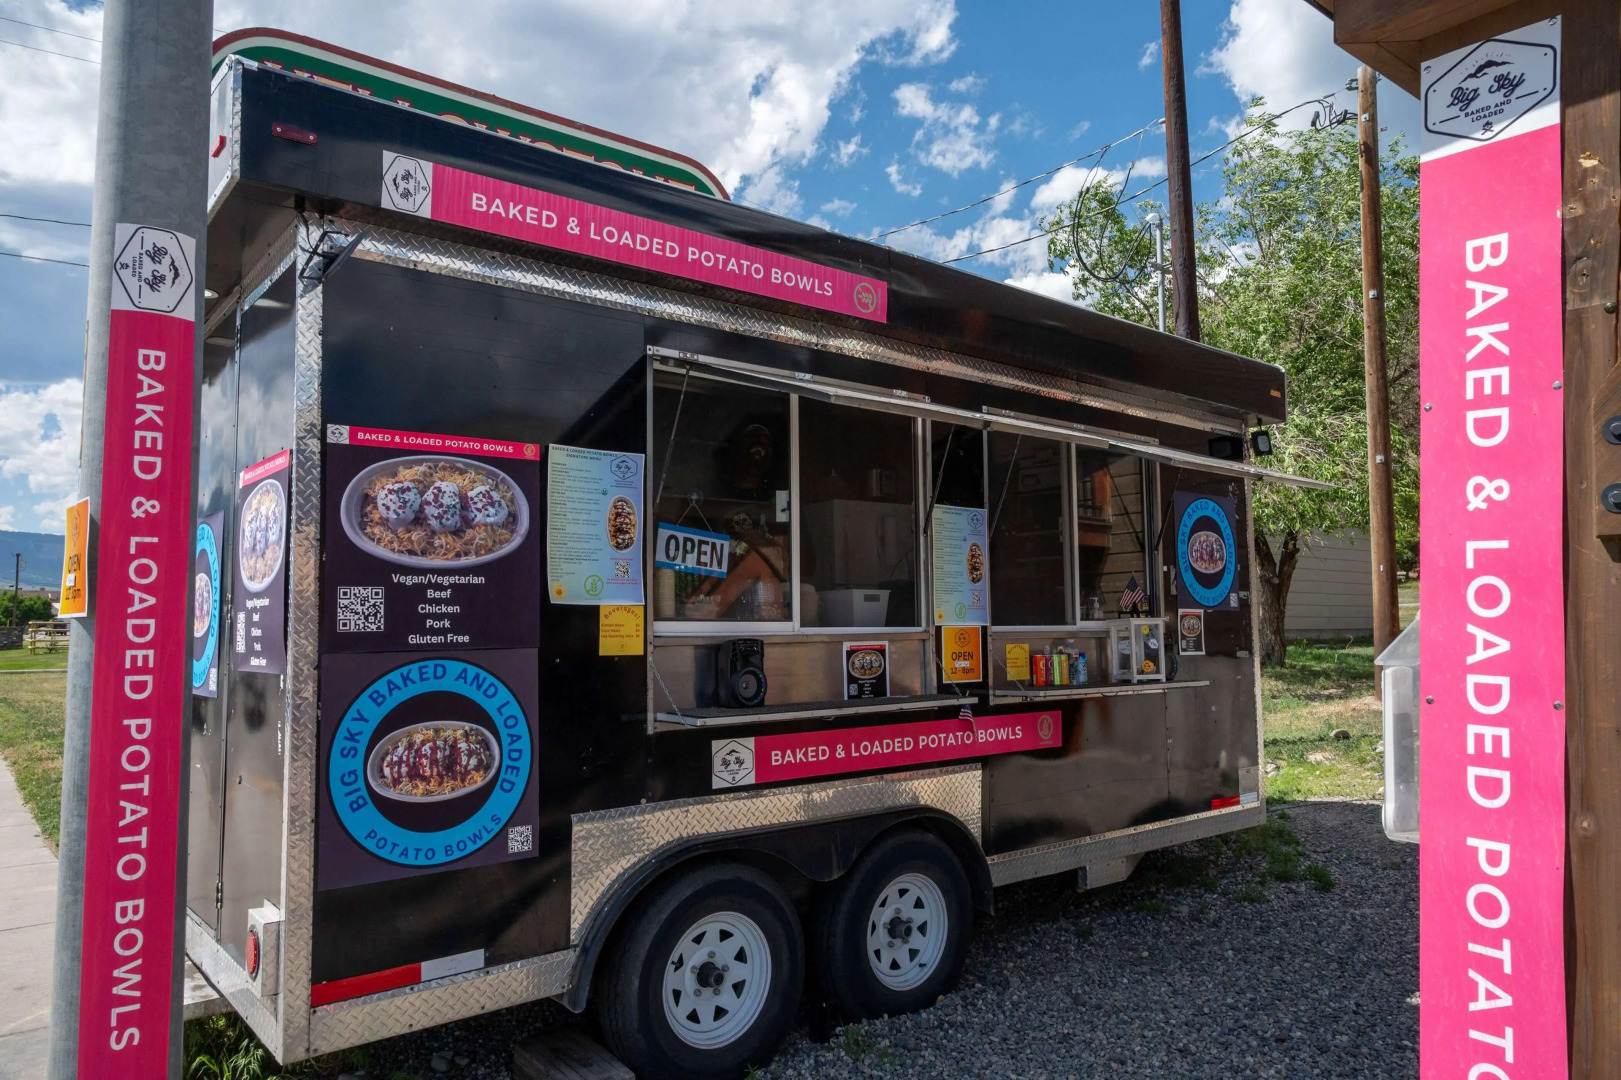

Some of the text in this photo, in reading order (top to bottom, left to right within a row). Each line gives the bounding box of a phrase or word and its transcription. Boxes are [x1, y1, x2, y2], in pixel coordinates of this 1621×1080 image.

[1446, 72, 1526, 112] Big Sky
[1464, 98, 1512, 118] BAKED AND
[1471, 108, 1504, 123] LOADED
[471, 192, 833, 296] BAKED & LOADED POTATO BOWLS
[144, 242, 168, 293] Big Sky
[1465, 232, 1510, 448] BAKED
[358, 432, 391, 442] BAKED
[404, 436, 442, 446] LOADED
[445, 440, 480, 450] POTATO
[483, 443, 513, 453] BOWLS
[1466, 475, 1510, 512] &
[665, 534, 724, 569] OPEN
[1180, 522, 1189, 544] SKY
[1187, 501, 1208, 518] BAKED
[1211, 504, 1224, 523] AND
[1223, 526, 1233, 575] LOADED
[392, 574, 485, 585] Vegan/Vegetarian
[427, 589, 452, 598] Beef
[1189, 584, 1210, 604] POTATO
[418, 604, 460, 613] Chicken
[426, 619, 450, 628] Pork
[604, 606, 640, 620] Beverages!
[408, 634, 470, 644] Gluten Free
[951, 652, 973, 661] OPEN
[1465, 540, 1511, 808] LOADED
[110, 348, 166, 1051] BAKED & LOADED POTATO BOWLS
[340, 663, 523, 814] BIG SKY BAKED AND LOADED
[771, 726, 1022, 766] BAKED & LOADED POTATO BOWLS
[364, 813, 502, 861] POTATO BOWLS
